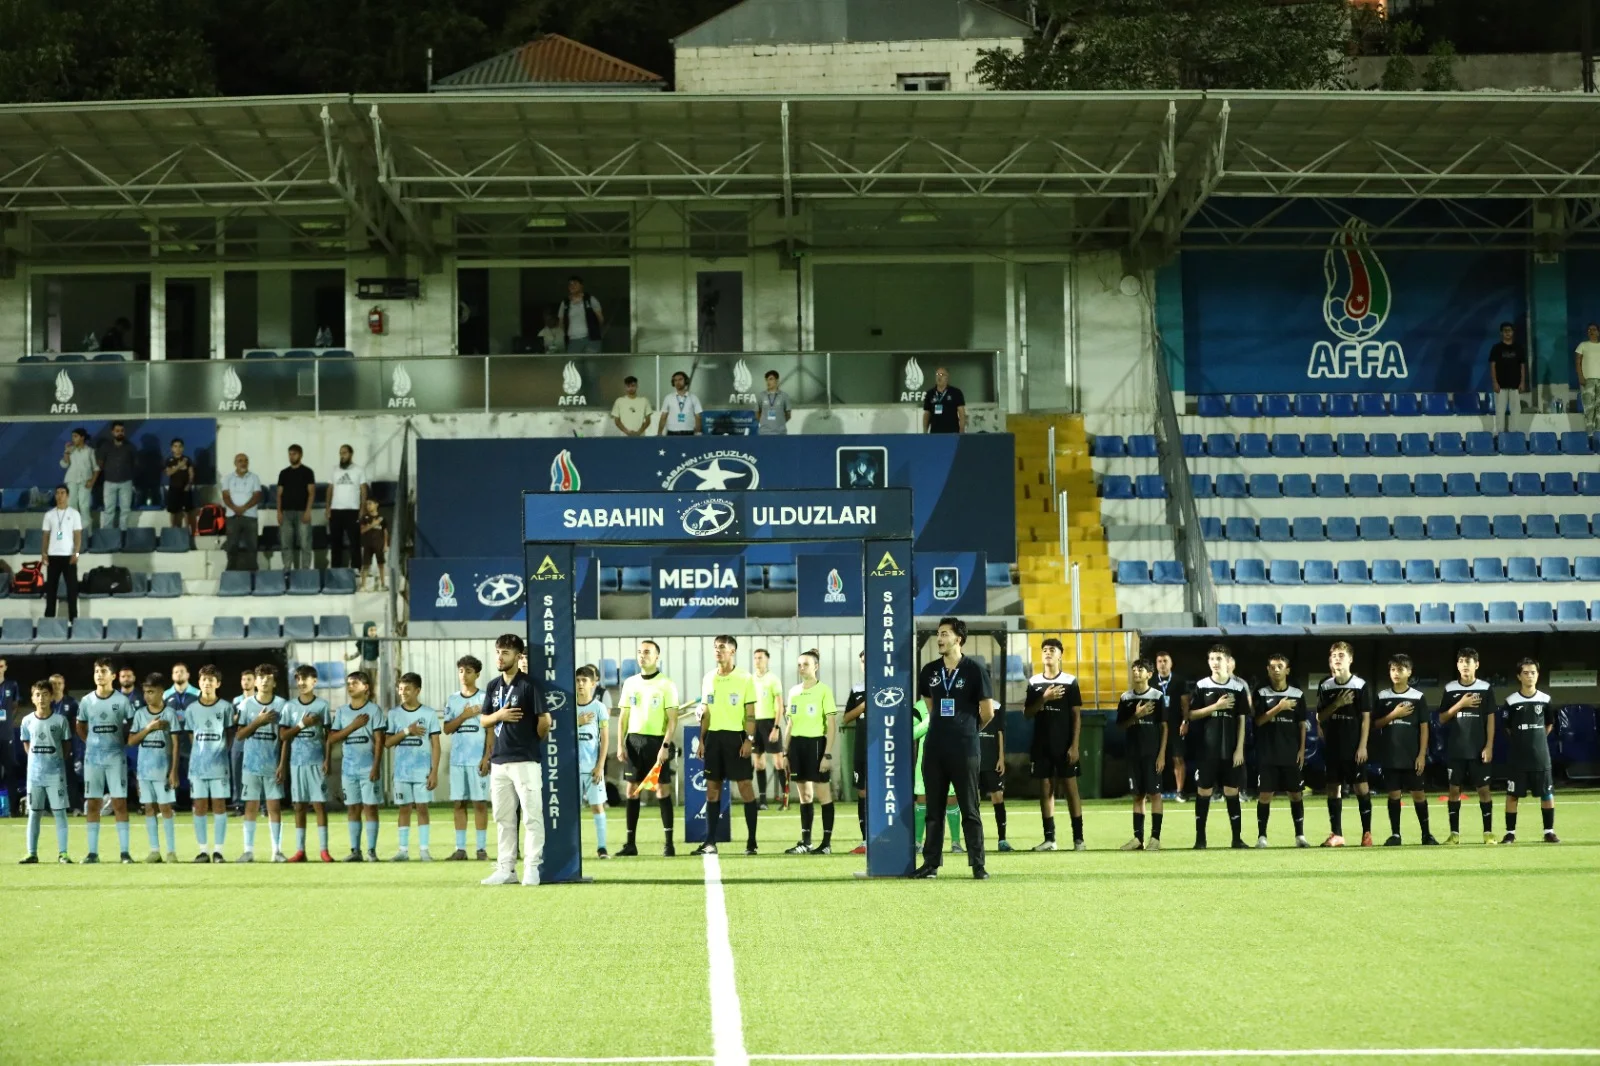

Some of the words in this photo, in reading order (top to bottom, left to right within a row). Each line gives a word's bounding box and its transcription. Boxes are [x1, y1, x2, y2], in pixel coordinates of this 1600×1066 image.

[1307, 341, 1408, 378] AFFA
[218, 400, 247, 411] AFFA
[388, 397, 416, 408] AFFA
[558, 395, 587, 406] AFFA
[729, 393, 757, 403] AFFA
[50, 403, 78, 413] AFFA
[661, 457, 698, 489] SABAHIN
[703, 450, 758, 465] ULDUZLARI
[563, 508, 664, 528] SABAHIN
[752, 506, 876, 526] ULDUZLARI
[530, 573, 565, 581] ALPEX
[660, 563, 739, 589] MEDİA
[870, 569, 905, 577] ALPEX
[660, 597, 688, 607] BAYIL
[689, 595, 739, 607] STADİONU
[543, 595, 556, 681] SABAHIN
[883, 591, 895, 677] SABAHIN
[884, 715, 896, 826] ULDUZLARI
